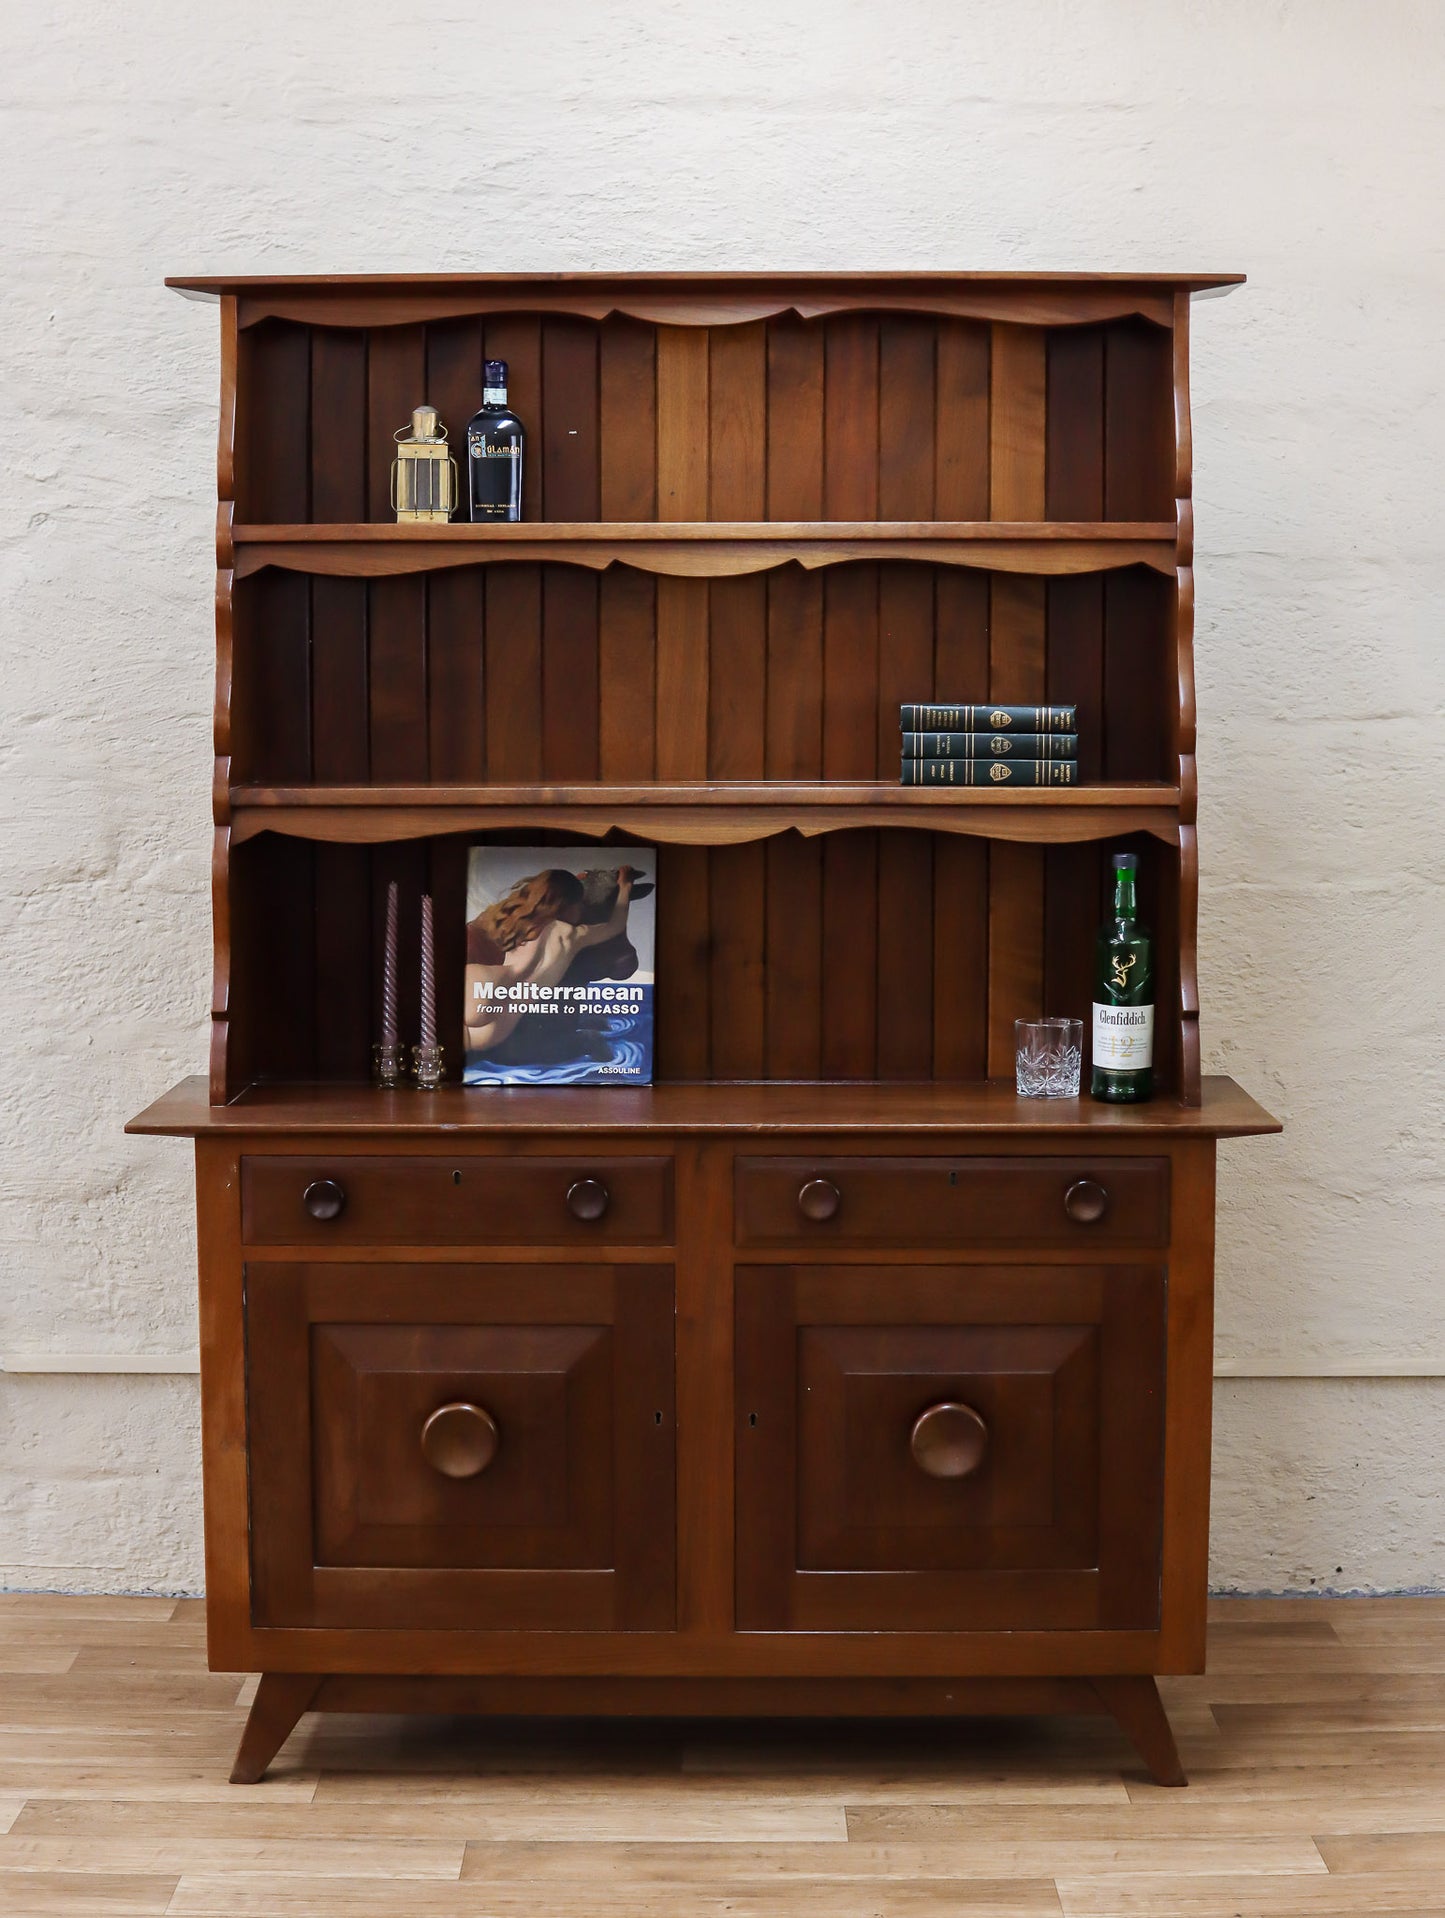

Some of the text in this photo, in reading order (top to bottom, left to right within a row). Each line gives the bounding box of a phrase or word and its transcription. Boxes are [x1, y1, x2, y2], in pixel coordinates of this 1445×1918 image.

[473, 982, 644, 1001] Mediterranean
[476, 1003, 640, 1014] from HOMER to PICASSO
[1099, 1009, 1146, 1025] Glenfiddich
[1110, 1034, 1136, 1058] 12
